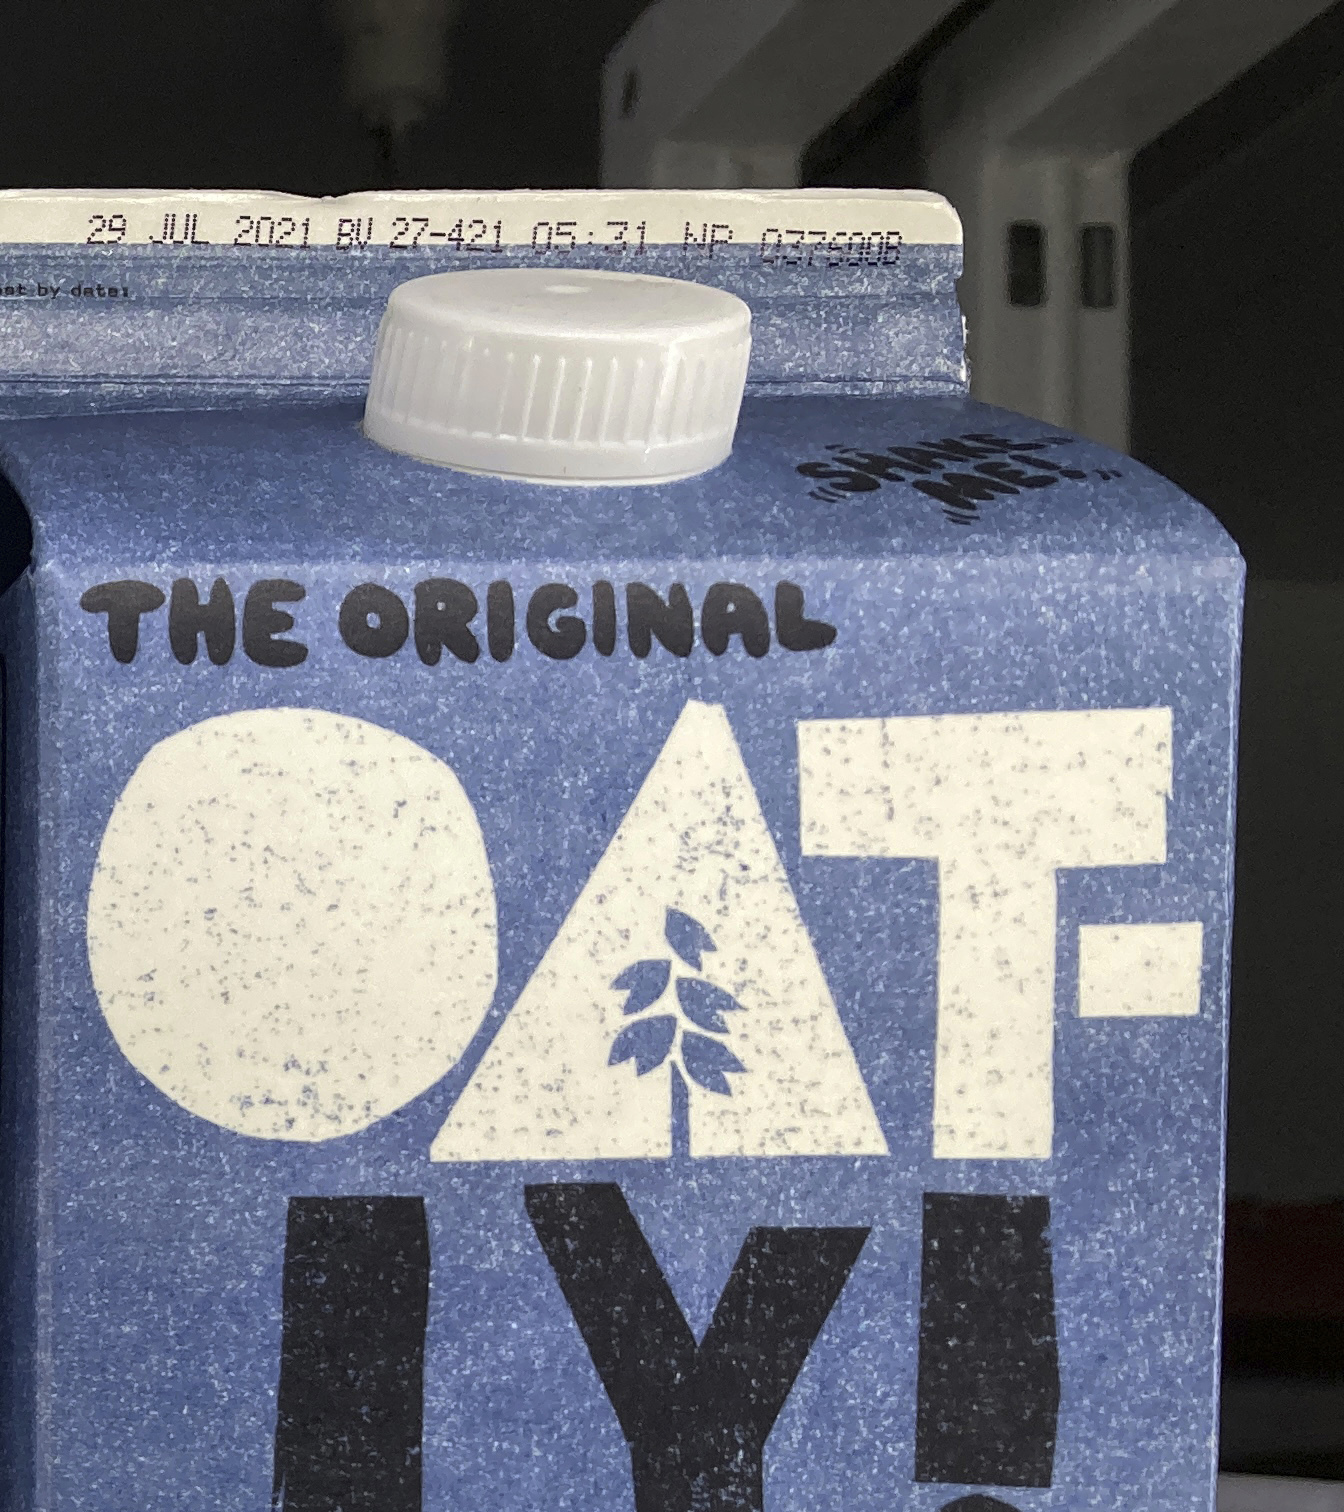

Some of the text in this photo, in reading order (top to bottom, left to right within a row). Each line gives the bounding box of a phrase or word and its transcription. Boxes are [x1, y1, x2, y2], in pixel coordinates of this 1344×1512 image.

[86, 213, 127, 245] 29
[149, 213, 210, 245] JUL
[233, 215, 310, 249] 2021
[335, 217, 374, 251] BV
[390, 216, 503, 253] 27-421
[531, 220, 646, 255] 05:31
[683, 221, 733, 258] NP
[37, 282, 60, 300] by
[79, 576, 838, 669] THE ORIGINAL
[86, 699, 1205, 1163] OAT-
